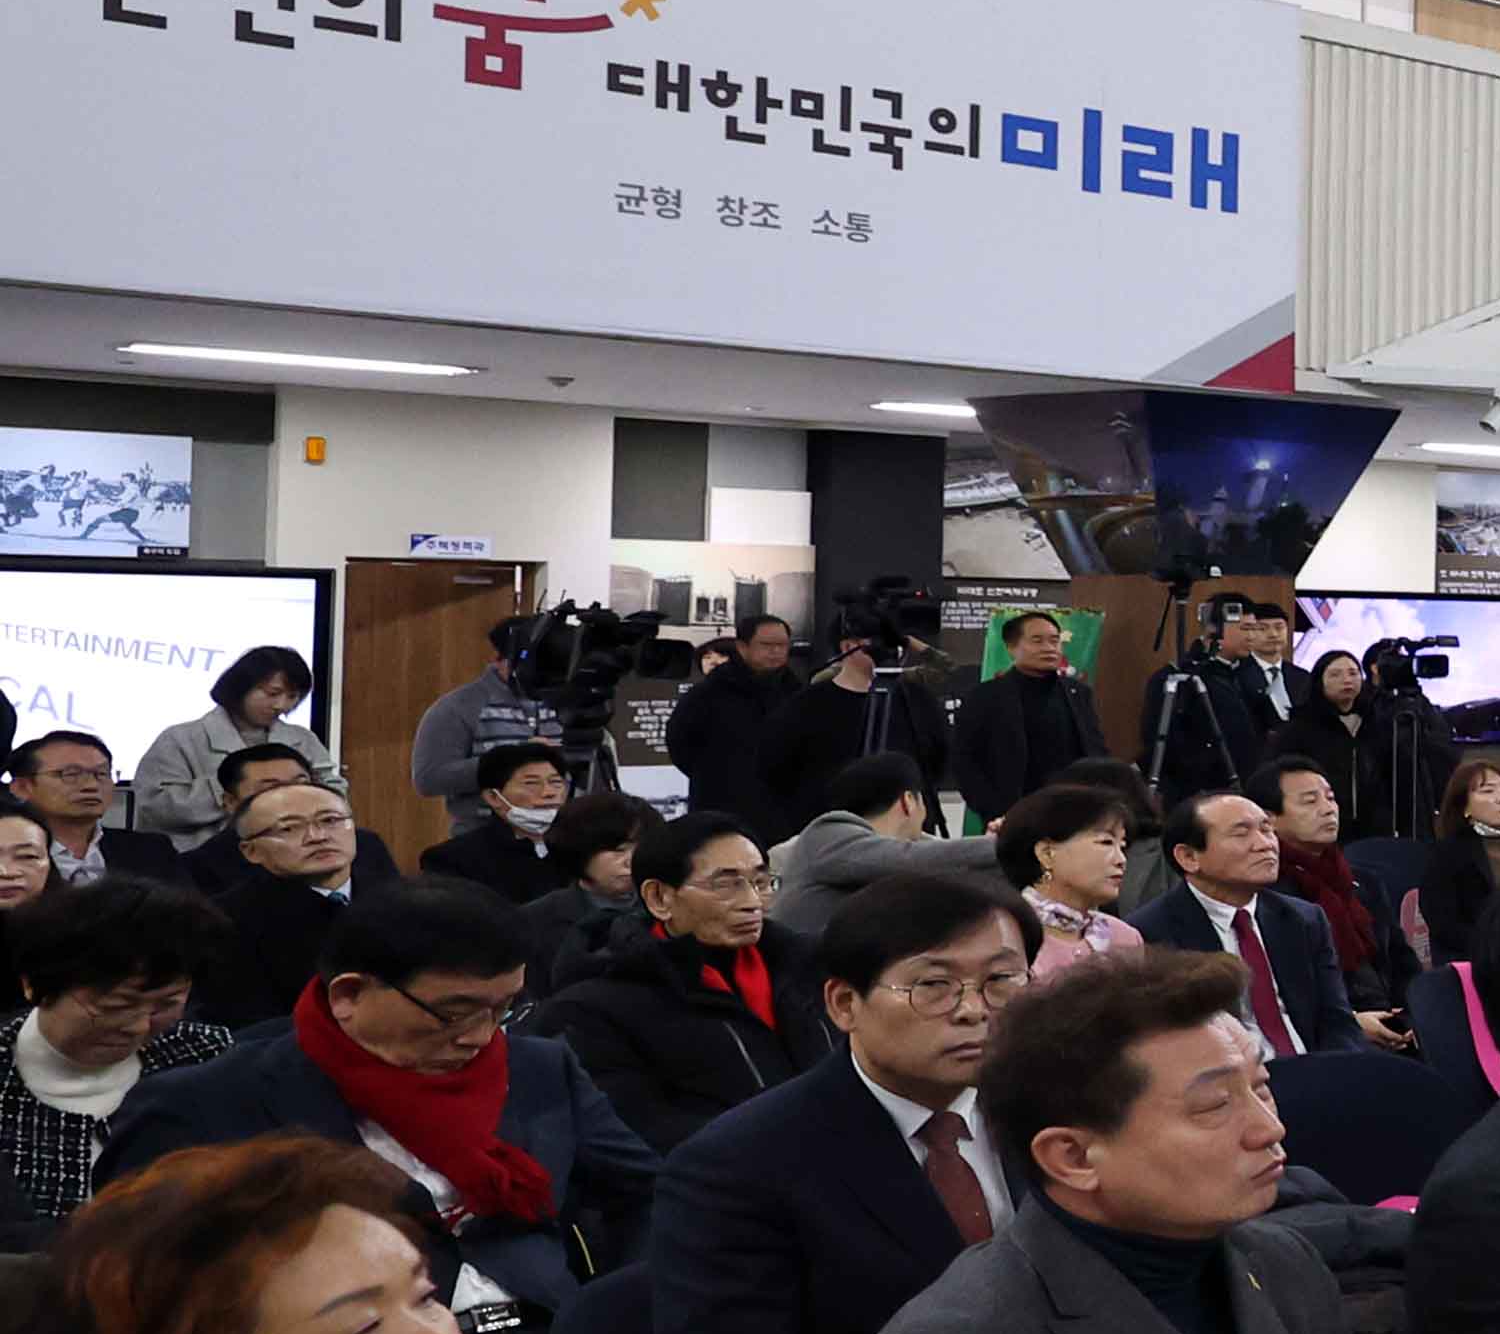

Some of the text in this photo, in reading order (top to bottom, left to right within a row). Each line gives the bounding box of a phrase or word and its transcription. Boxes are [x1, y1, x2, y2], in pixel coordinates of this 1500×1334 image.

[606, 60, 1239, 214] 대한민국의 미래
[614, 182, 873, 243] 균형 창조 소통
